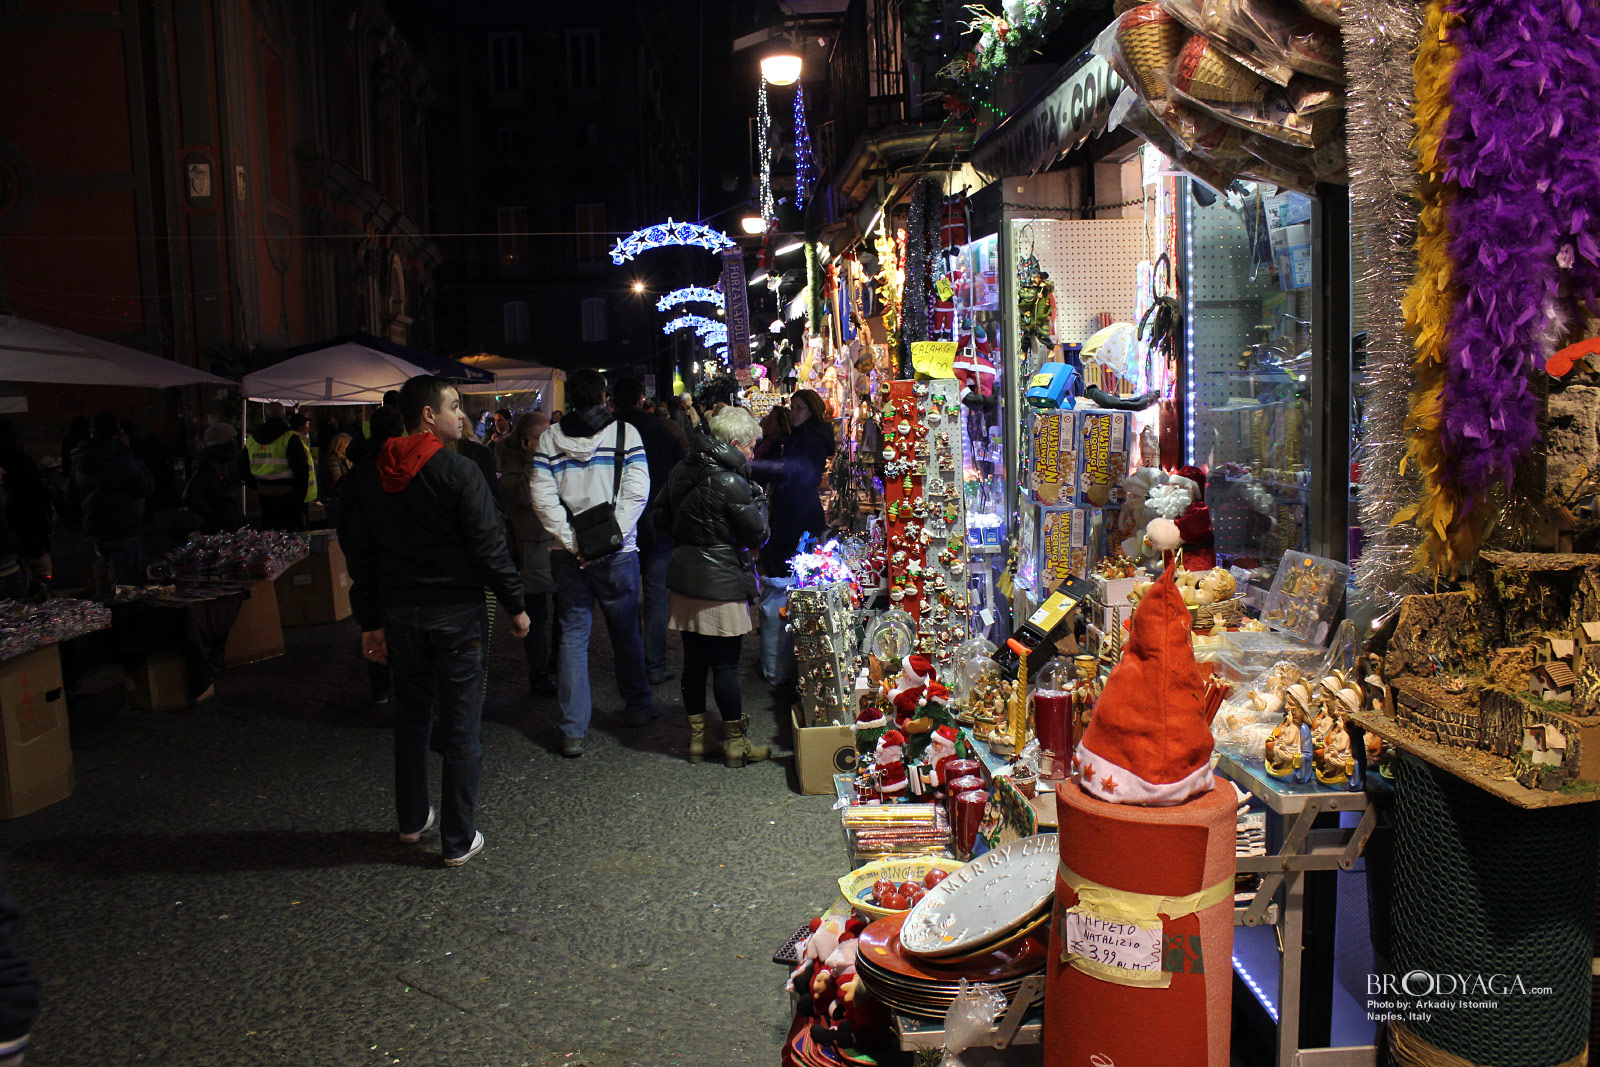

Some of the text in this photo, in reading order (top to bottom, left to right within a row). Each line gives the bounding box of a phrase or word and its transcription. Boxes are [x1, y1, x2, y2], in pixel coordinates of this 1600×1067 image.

[1071, 63, 1127, 132] COLO
[729, 266, 744, 340] FORZA NAPOLI
[1036, 426, 1048, 473] TOMBOLA
[1044, 415, 1060, 484] NAPOLETANA
[1086, 427, 1098, 473] TOMBOLA
[1094, 415, 1111, 485] NAPOLETANA
[1048, 523, 1059, 569] TOMBOLA
[1056, 511, 1071, 580] NAPOLETANA
[941, 845, 1013, 895] MERRY
[1067, 912, 1136, 935] TAPPETO
[1089, 945, 1117, 965] 3,99
[1117, 961, 1130, 971] AL
